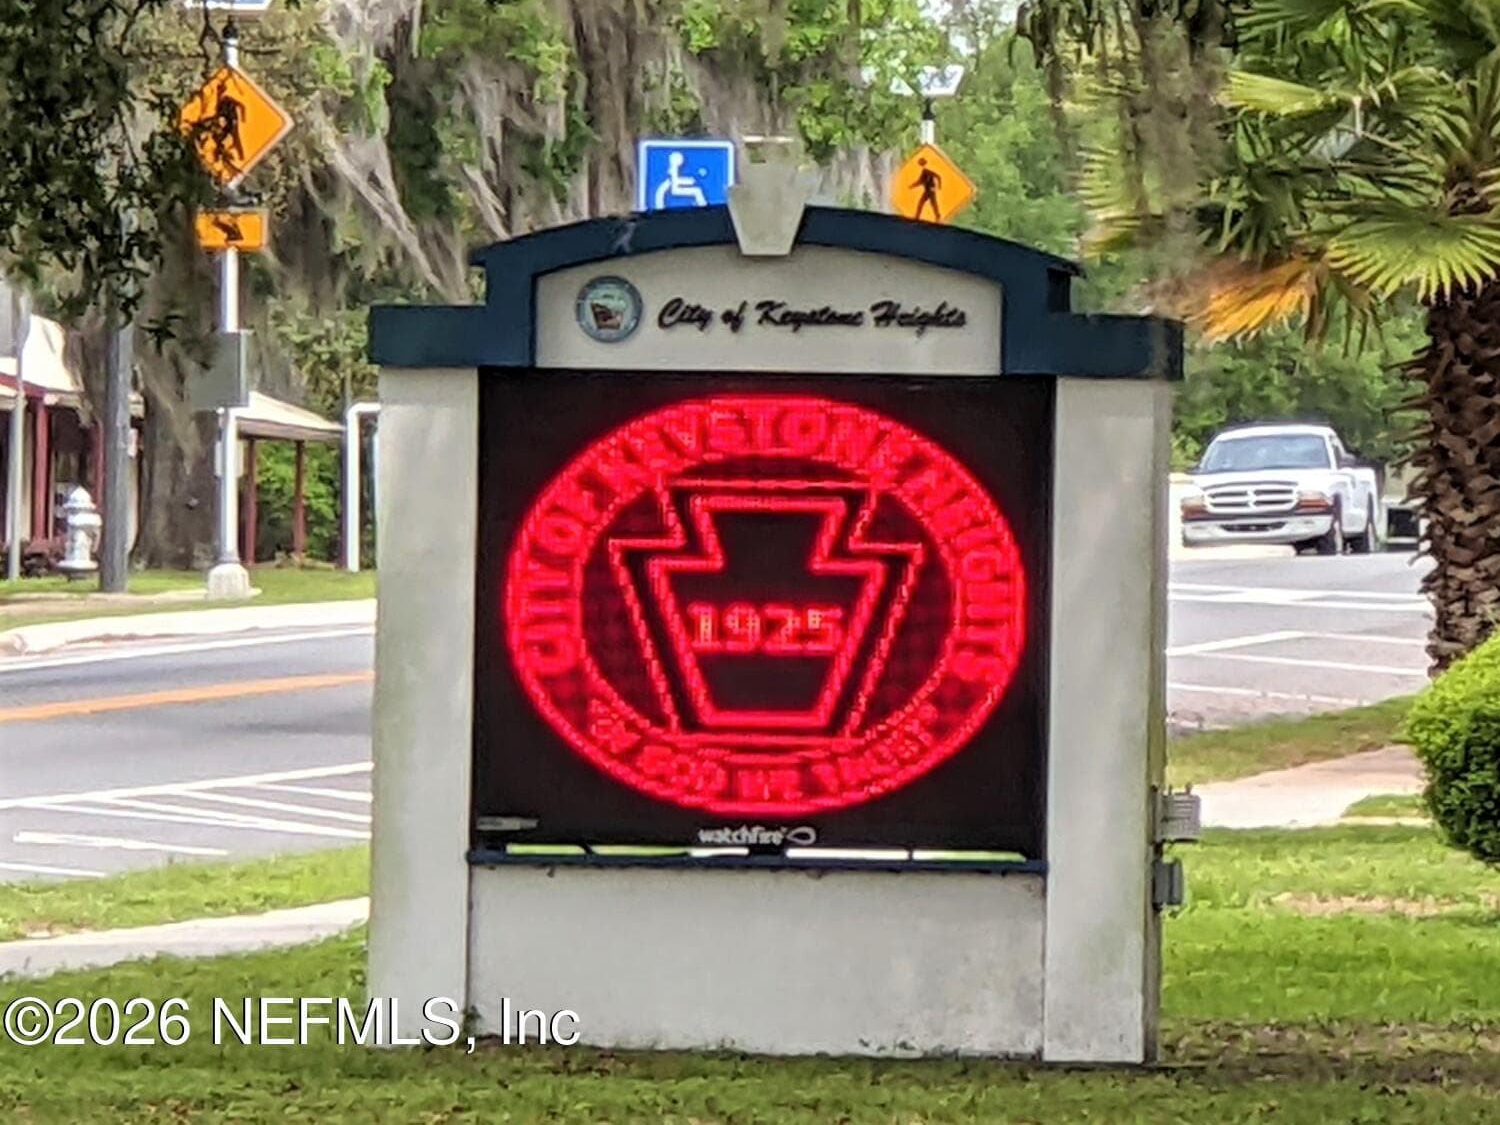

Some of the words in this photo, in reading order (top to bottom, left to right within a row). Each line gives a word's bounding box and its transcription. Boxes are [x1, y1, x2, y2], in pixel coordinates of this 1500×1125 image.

[657, 297, 713, 331] City
[721, 300, 749, 333] of
[756, 300, 865, 333] Keystone
[869, 300, 968, 340] Heights
[686, 601, 845, 653] 1925
[697, 825, 784, 845] watchfire
